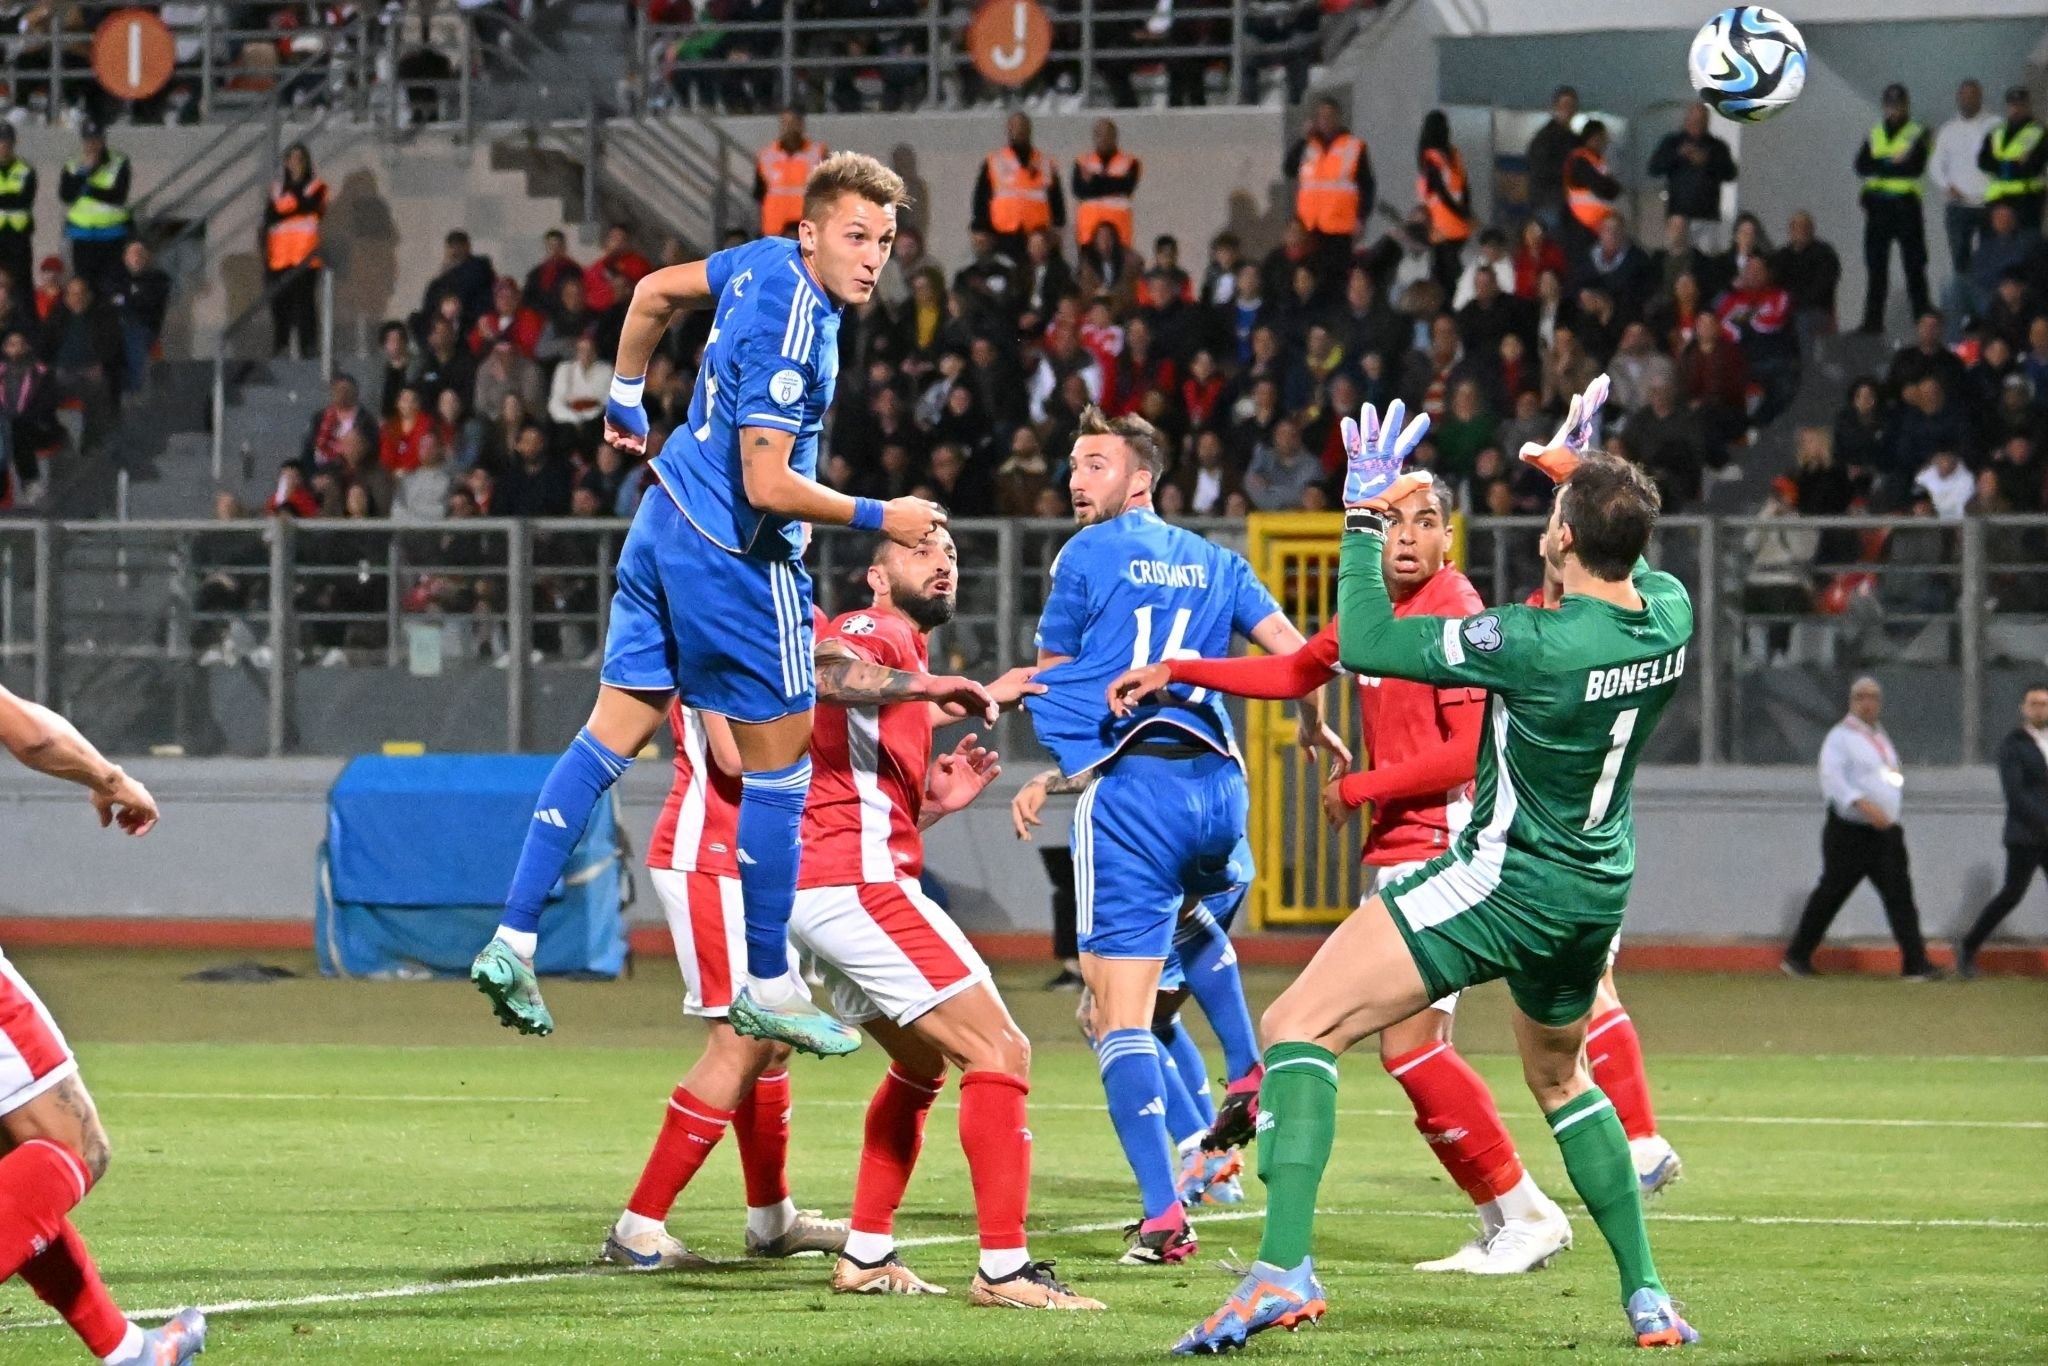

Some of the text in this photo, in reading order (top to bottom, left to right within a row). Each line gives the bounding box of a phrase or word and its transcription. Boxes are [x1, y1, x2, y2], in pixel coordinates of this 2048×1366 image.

[991, 1, 1027, 70] J
[1584, 645, 1686, 702] BONELLO
[1582, 707, 1640, 832] 1
